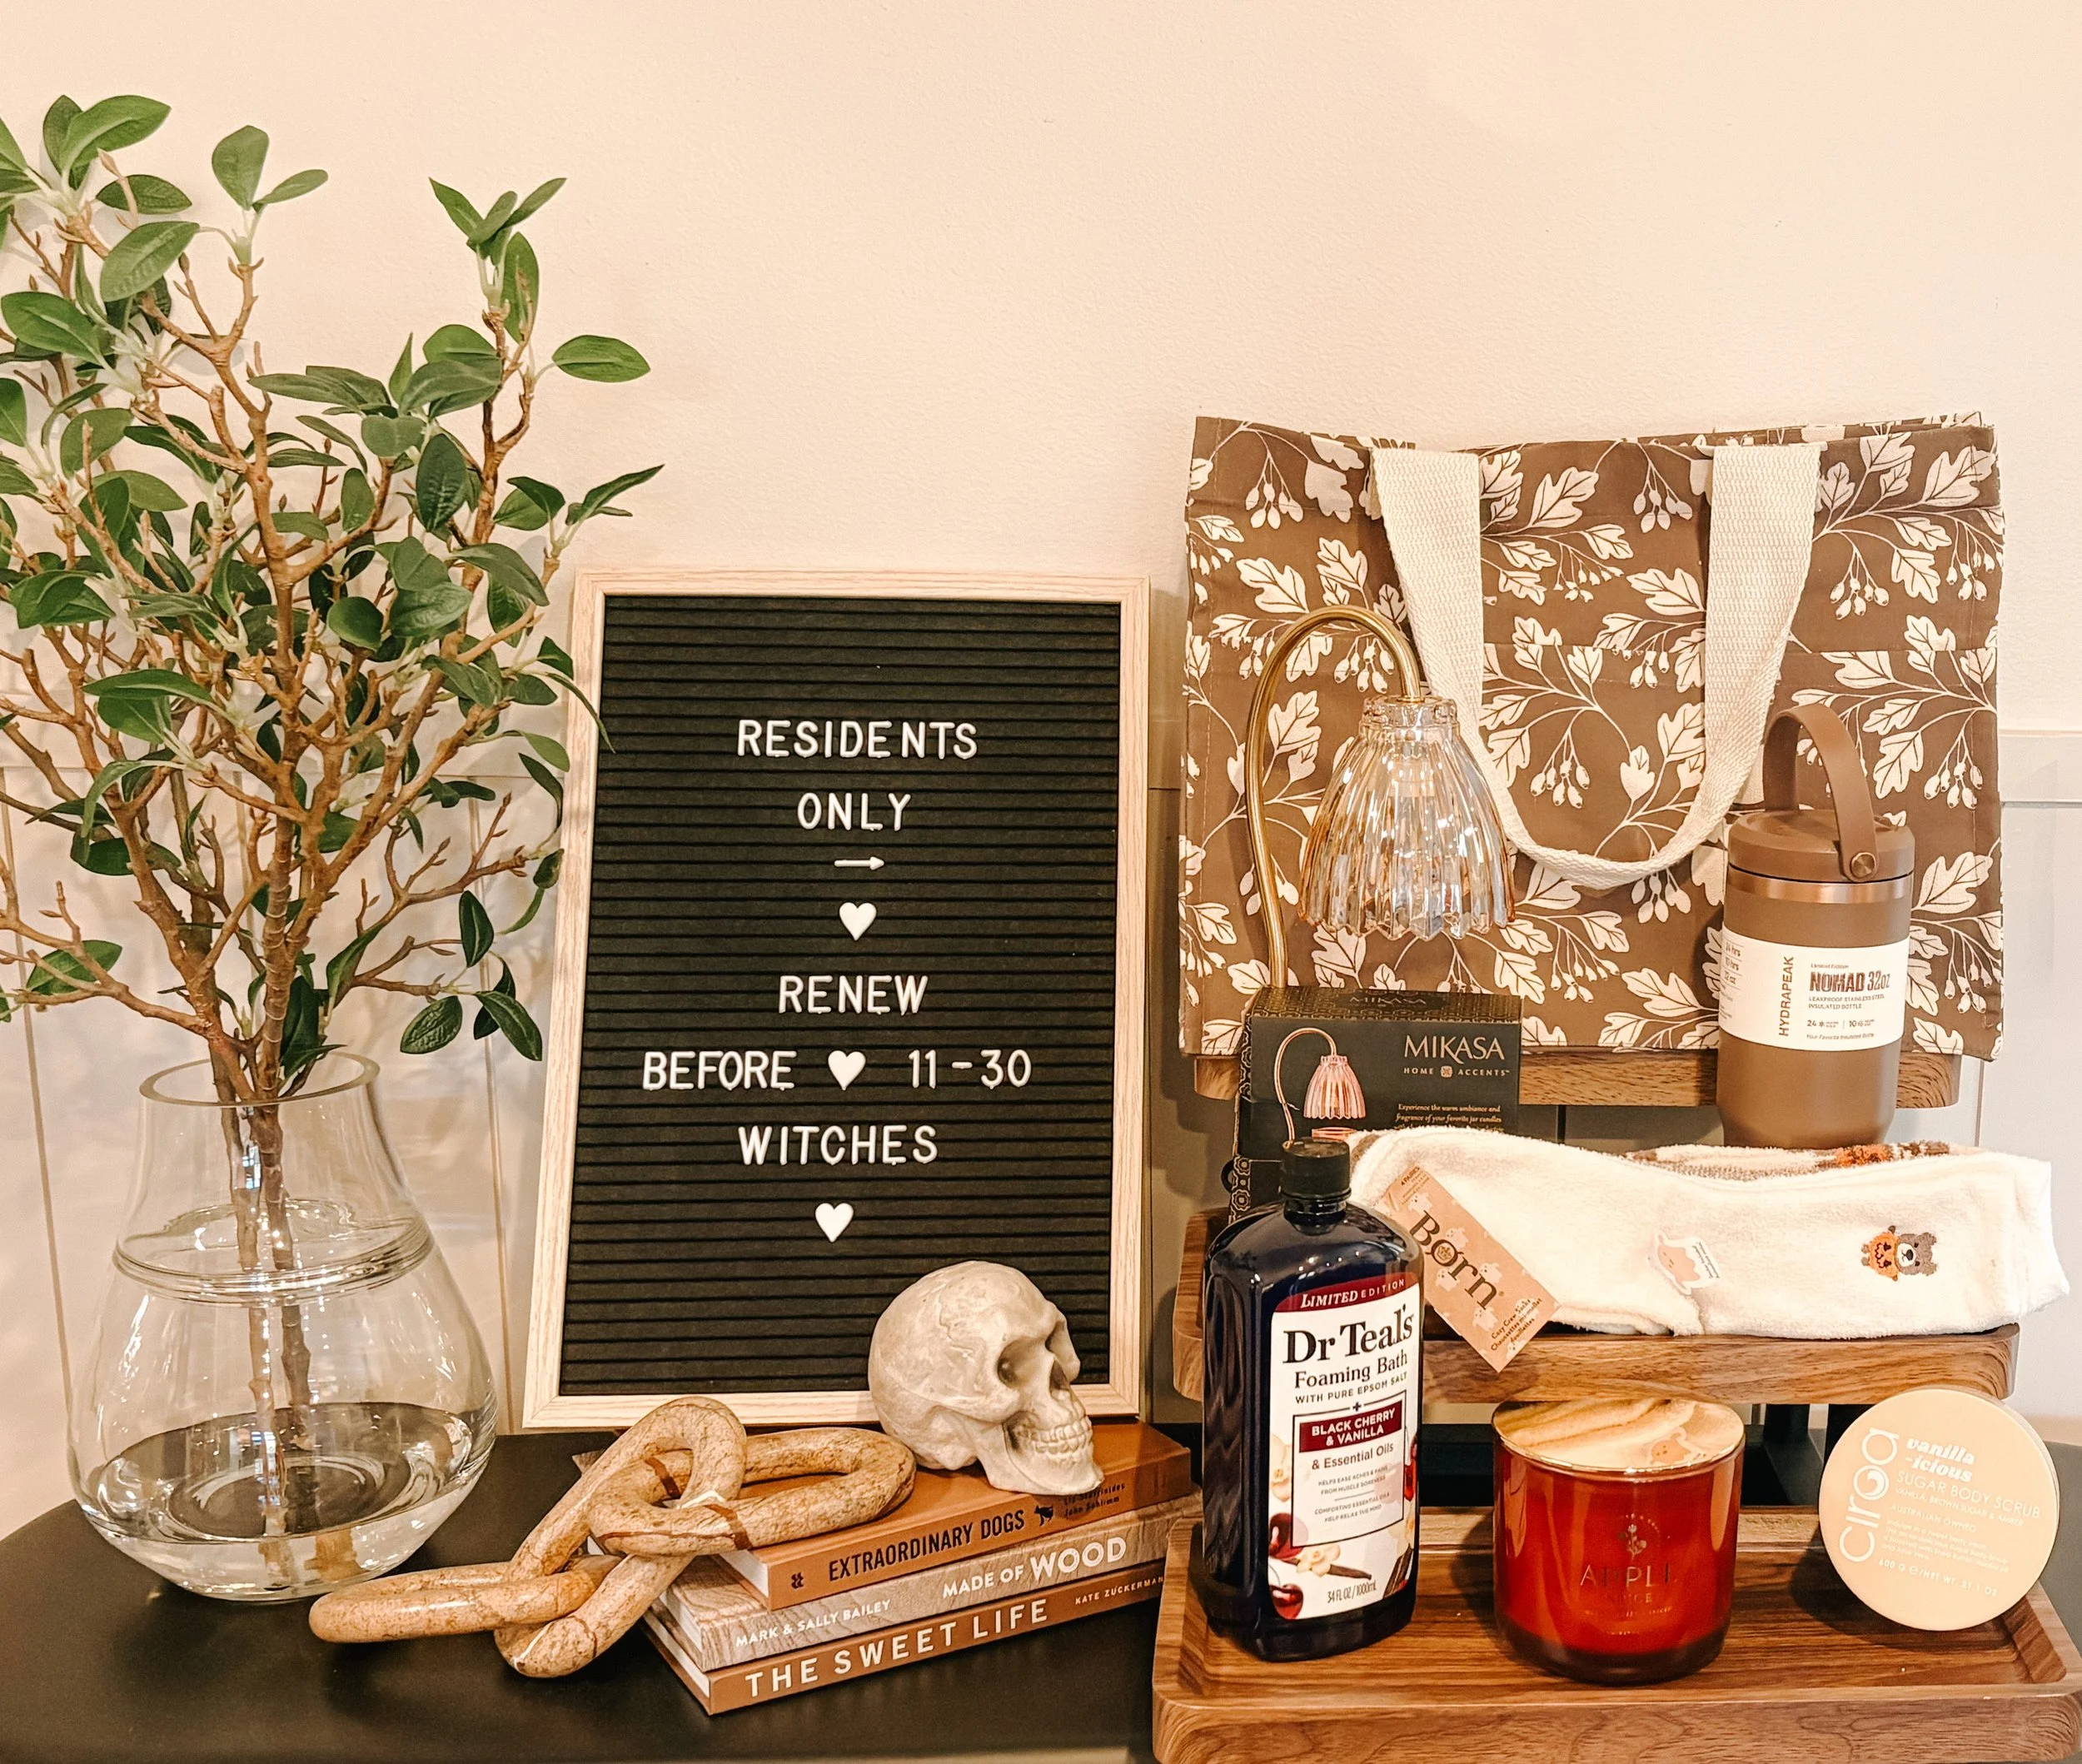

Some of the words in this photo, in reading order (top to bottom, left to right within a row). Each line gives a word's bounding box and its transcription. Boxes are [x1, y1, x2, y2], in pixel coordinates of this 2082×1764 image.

[737, 719, 978, 760] RESIDENTS
[797, 793, 911, 831] ONLY
[778, 974, 928, 1015] RENEW
[1779, 956, 1794, 1037] HYDRAPEAK
[1810, 971, 1865, 992] NOMAD
[1867, 970, 1890, 991] 32oz
[1849, 1019, 1857, 1028] 10
[1404, 1034, 1505, 1064] MIKASA
[642, 1050, 797, 1090] BEFORE
[738, 1124, 938, 1165] WITCHES
[1361, 1279, 1405, 1298] EDITION
[1283, 1329, 1336, 1364] Dr
[1339, 1303, 1415, 1358] Teal's
[1294, 1365, 1371, 1389] Foaming
[1377, 1349, 1407, 1374] Bath
[1295, 1393, 1323, 1404] WITH
[1327, 1388, 1353, 1400] PURE
[1357, 1382, 1387, 1393] EPSOM
[1390, 1371, 1407, 1385] SALT
[1311, 1421, 1351, 1438] BLACK
[1354, 1408, 1396, 1428] CHERRY
[1326, 1436, 1334, 1448] &
[1337, 1427, 1384, 1445] VANILLA
[1312, 1459, 1320, 1470] &
[1323, 1449, 1373, 1468] Essential
[1376, 1442, 1394, 1457] Oils
[1906, 1438, 1975, 1465] vanilla
[1338, 1483, 1359, 1492] MUSCLE
[1352, 1497, 1379, 1508] ESSENTIAL
[1897, 1471, 1946, 1494] SUGAR
[1950, 1485, 1992, 1504] BODY
[1994, 1495, 2040, 1519] SCRUB
[1890, 1503, 1942, 1523] AUSTRALIAN
[1943, 1517, 1976, 1532] OWNED
[829, 1523, 974, 1582] EXTRAORDINARY
[981, 1510, 1025, 1541] DOGS
[942, 1571, 994, 1599] MADE
[1000, 1565, 1024, 1583] OF
[1029, 1537, 1128, 1582] WOOD
[1075, 1592, 1100, 1605] KATE
[1104, 1576, 1163, 1597] ZUCKERMAN
[735, 1626, 778, 1647] MARK
[783, 1623, 794, 1636] &
[798, 1612, 838, 1632] SALLY
[843, 1599, 891, 1621] BAILEY
[745, 1657, 819, 1698] THE
[833, 1622, 958, 1675] SWEET
[973, 1598, 1048, 1639] LIFE
